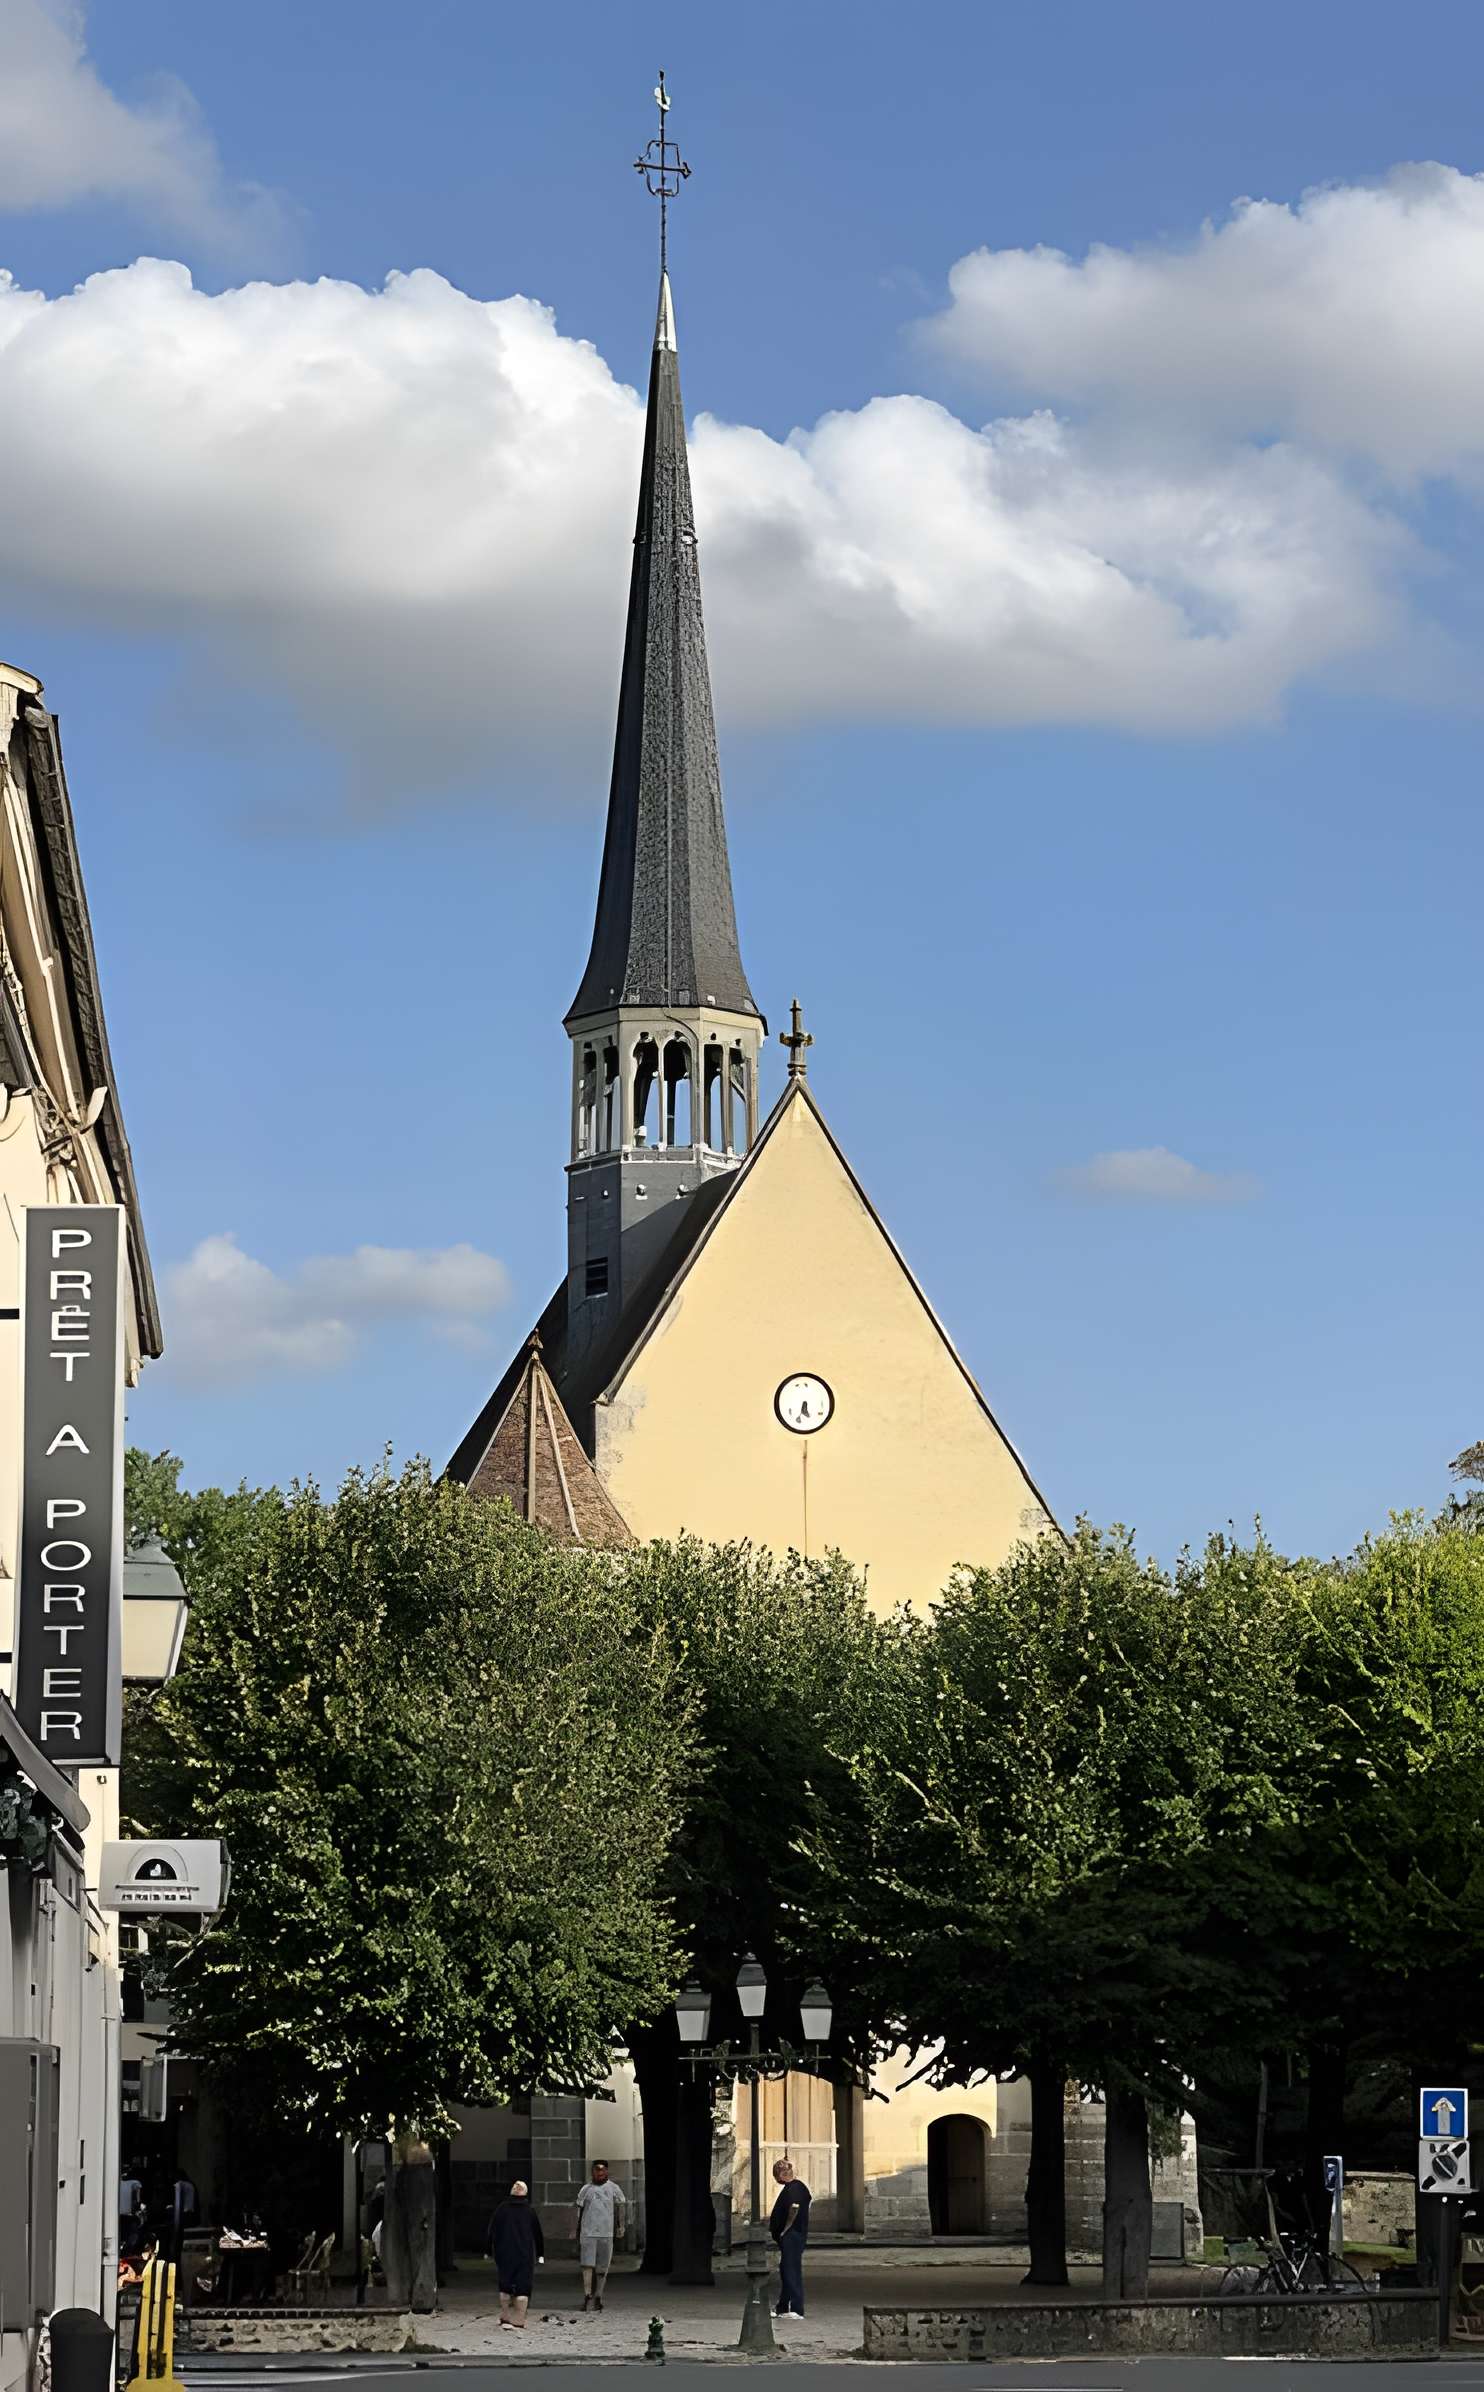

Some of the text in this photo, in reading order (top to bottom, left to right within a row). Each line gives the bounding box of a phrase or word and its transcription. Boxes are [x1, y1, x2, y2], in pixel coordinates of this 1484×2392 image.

[40, 1229, 92, 1741] PRÊT A PORTER
